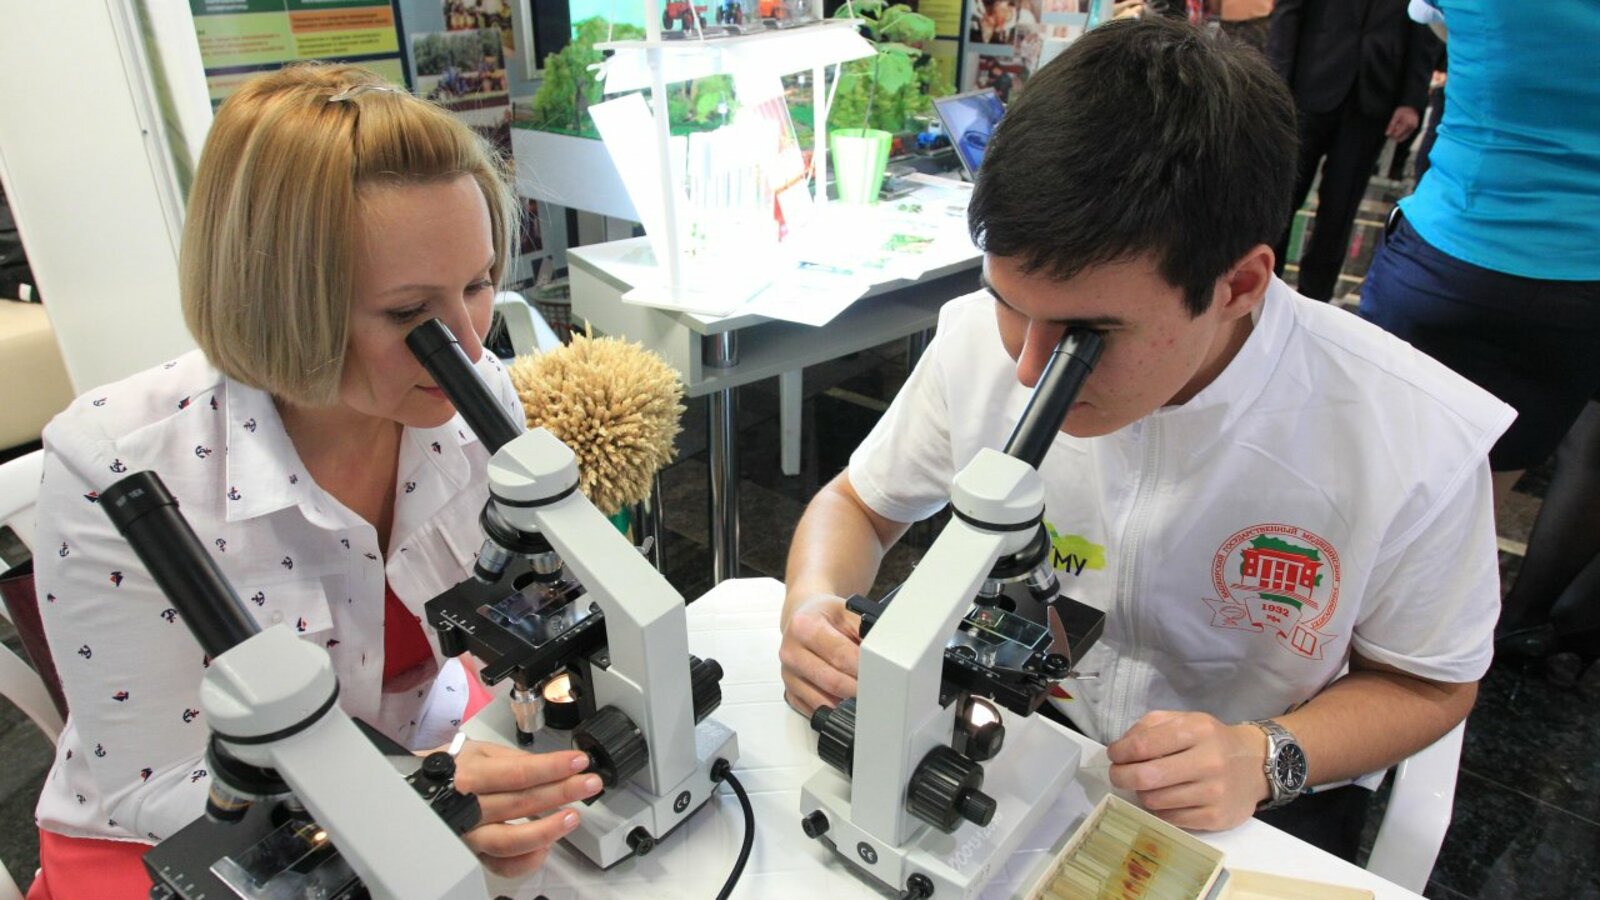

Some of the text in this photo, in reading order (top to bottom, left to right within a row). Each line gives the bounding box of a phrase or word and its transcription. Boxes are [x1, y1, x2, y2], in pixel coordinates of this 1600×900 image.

[1223, 525, 1298, 552] ГОСУДАРСТВЕННЫЙ
[1052, 545, 1088, 576] МУ
[1261, 602, 1290, 617] 1932
